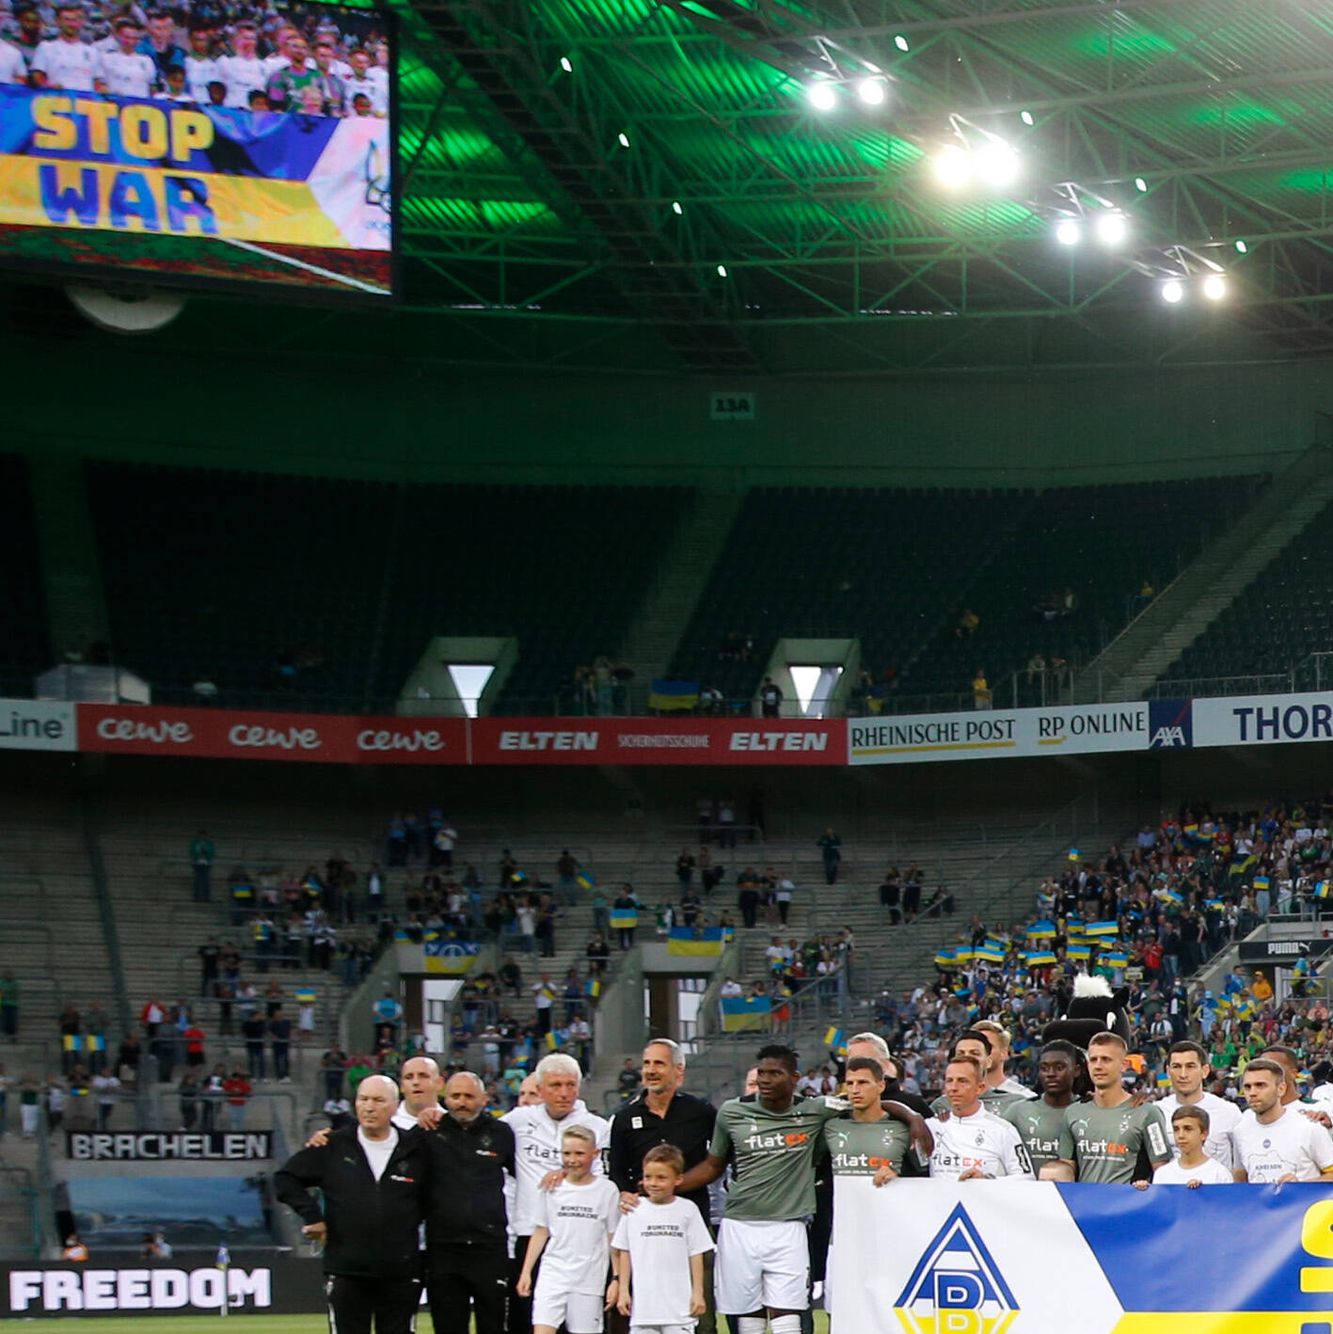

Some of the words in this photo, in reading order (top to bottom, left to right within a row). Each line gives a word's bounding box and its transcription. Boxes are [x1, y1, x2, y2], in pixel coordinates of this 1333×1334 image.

[31, 97, 215, 162] STOP
[38, 164, 219, 235] WAR
[97, 709, 193, 742] cewe
[228, 724, 322, 749] cewe
[852, 721, 959, 748] RHEINISCHE
[966, 719, 1016, 741] POST
[1039, 717, 1065, 737] RP
[1071, 711, 1146, 736] ONLINE
[1150, 727, 1186, 747] AXA
[356, 730, 446, 751] cewe
[499, 732, 599, 750] ELTEN
[729, 732, 817, 751] ELTEN
[1267, 941, 1300, 955] PUMA
[71, 1132, 268, 1160] BRACHELEN
[9, 1268, 271, 1311] FREEDOM
